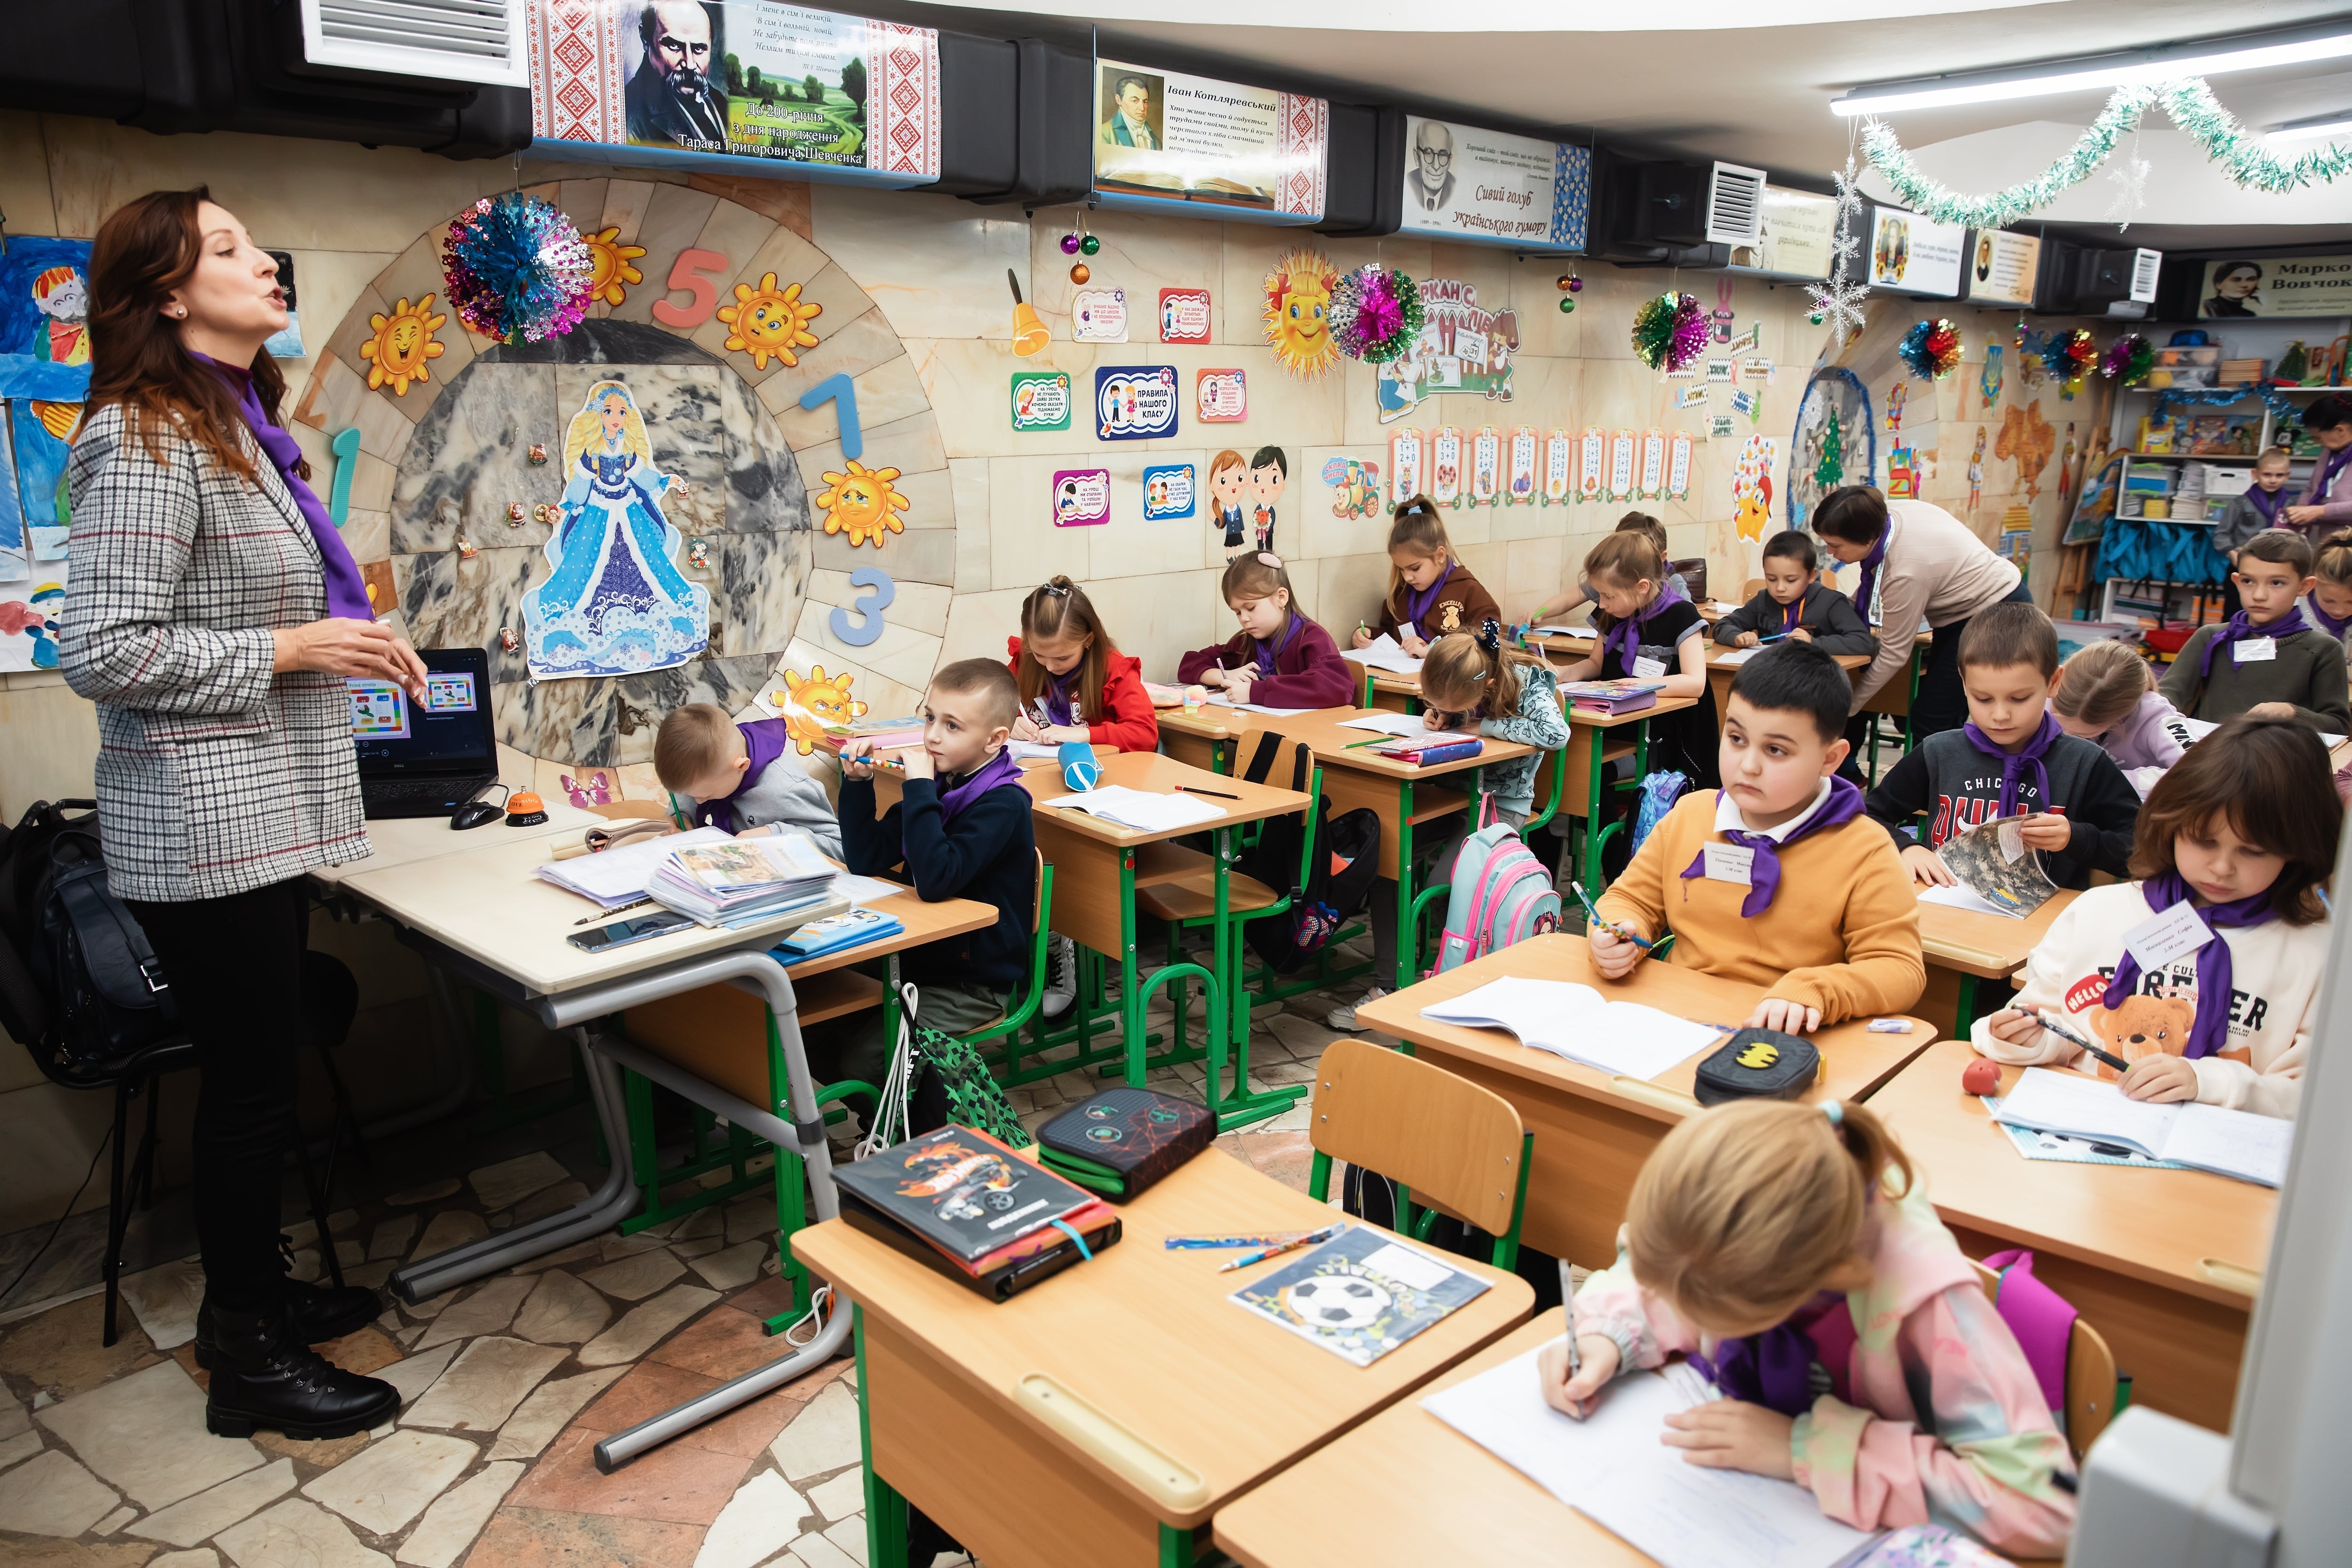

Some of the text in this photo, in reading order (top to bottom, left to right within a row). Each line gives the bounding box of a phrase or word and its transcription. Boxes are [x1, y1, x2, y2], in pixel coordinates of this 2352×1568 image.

[765, 32, 797, 42] забудьте
[755, 42, 783, 52] Незлим
[786, 48, 809, 57] тихим
[816, 64, 841, 74] Шевченко
[1168, 86, 1276, 111] Іван Котляревський
[746, 102, 824, 123] До 200-річчя
[1169, 115, 1202, 125] трудами
[1204, 120, 1229, 129] своїми,
[1234, 116, 1267, 126] годується
[733, 123, 839, 143] з дня народження
[1169, 125, 1206, 135] черствого
[1228, 135, 1264, 144] смачніший
[678, 134, 862, 165] Тараса Григоровича Шевченка
[1203, 139, 1224, 148] булки,
[1466, 143, 1486, 152] Хороший
[1476, 185, 1534, 210] Сивий голуб
[1453, 211, 1547, 238] українського гумору
[2278, 264, 2351, 275] Марко
[652, 248, 729, 328] 5
[2272, 279, 2352, 289] Вовчок
[1458, 331, 1485, 345] календар
[1470, 347, 1477, 355] 31
[1405, 431, 1408, 440] 2
[1485, 430, 1488, 438] 4
[1523, 429, 1526, 438] 5
[1326, 462, 1346, 471] СКЛАД
[830, 567, 895, 646] 3
[1964, 778, 2037, 797] CHICGO
[2145, 924, 2193, 952] Москаленко Софія
[2164, 945, 2173, 954] 2-М
[2067, 981, 2108, 1011] HELLO
